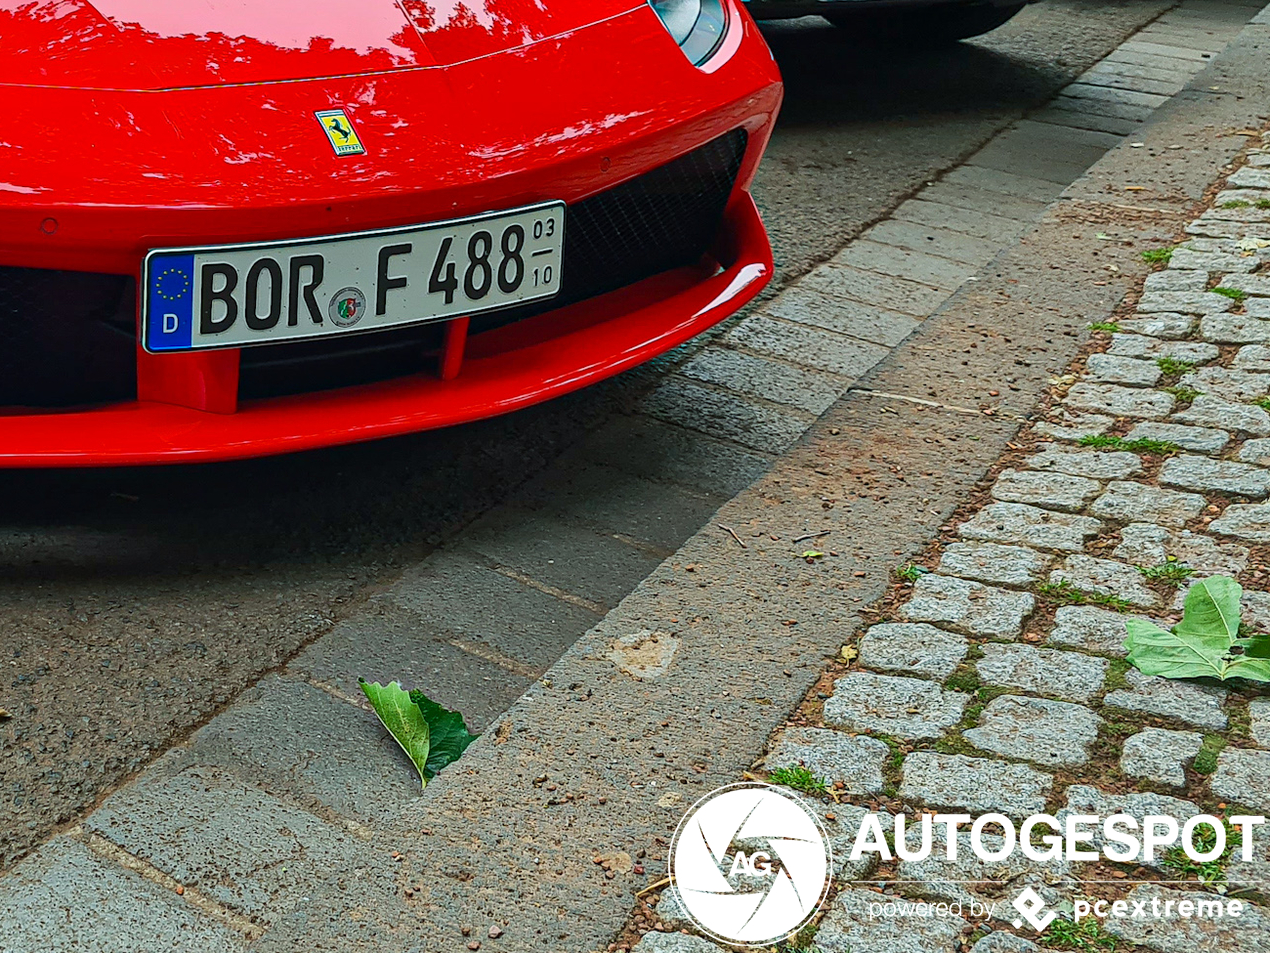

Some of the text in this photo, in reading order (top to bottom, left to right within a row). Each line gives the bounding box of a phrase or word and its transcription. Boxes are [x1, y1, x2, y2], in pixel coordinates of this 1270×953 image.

[533, 218, 555, 239] 03
[200, 255, 324, 335] BOR
[376, 243, 412, 315] F
[429, 224, 524, 305] 488
[533, 266, 552, 286] 10
[163, 314, 178, 333] D
